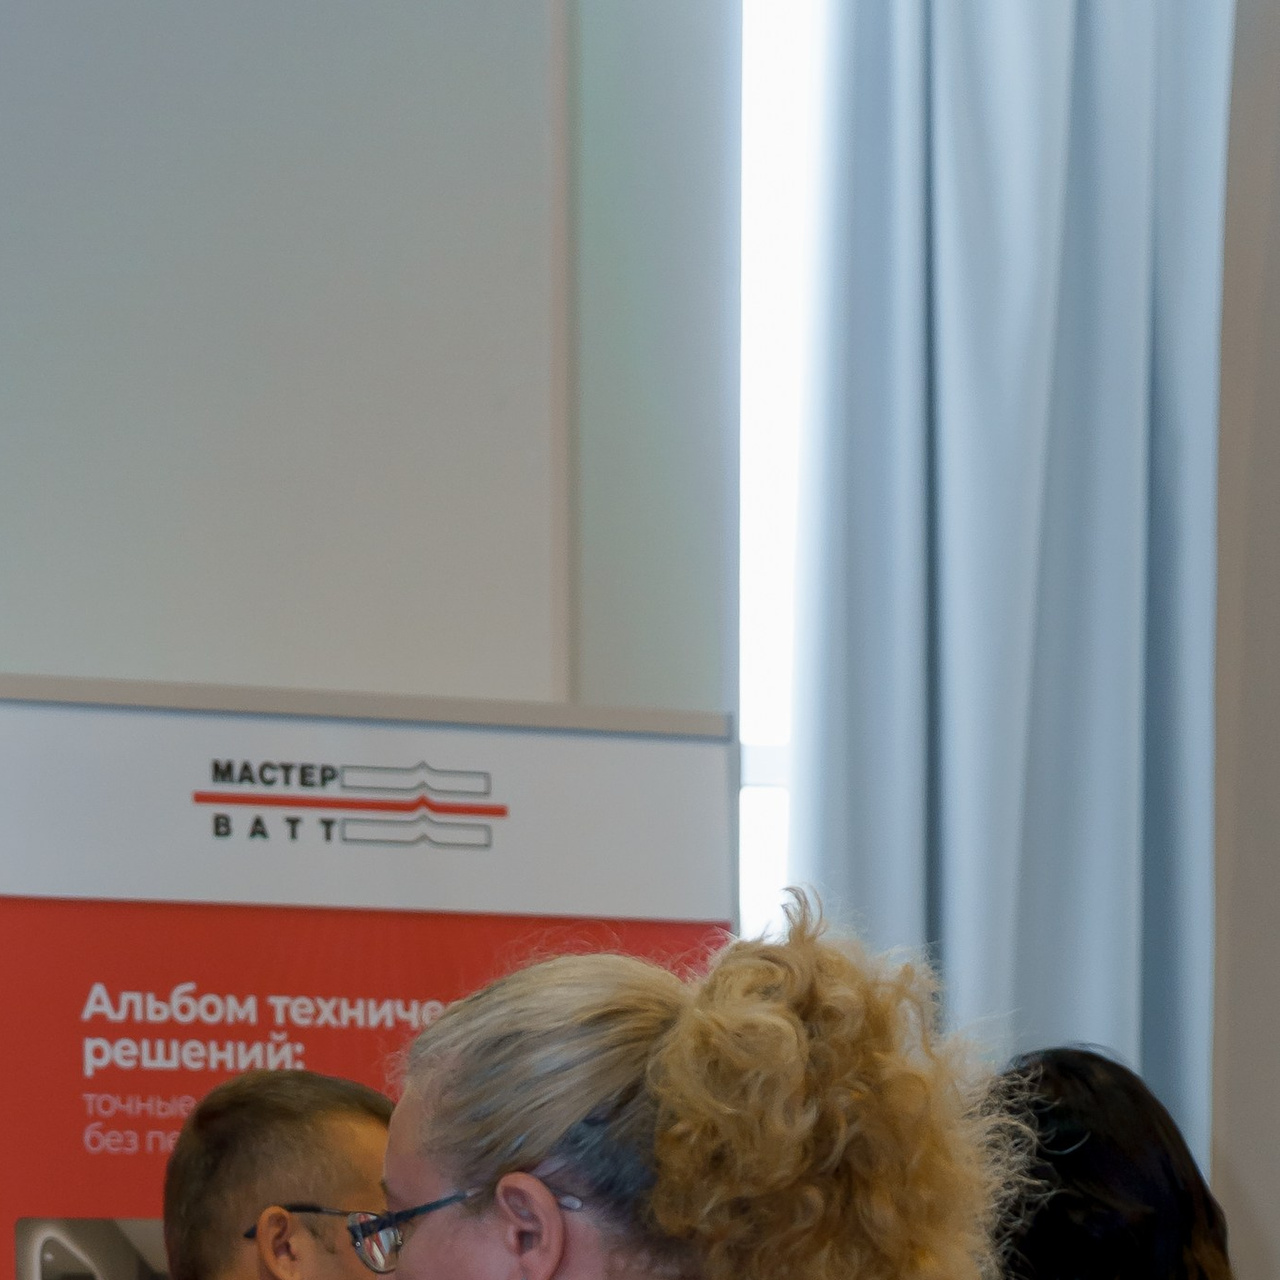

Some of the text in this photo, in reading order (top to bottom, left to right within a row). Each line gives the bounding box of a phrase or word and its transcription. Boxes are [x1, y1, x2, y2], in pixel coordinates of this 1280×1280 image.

[211, 759, 339, 788] МАСТЕР
[213, 813, 337, 842] ВАТТ
[82, 982, 258, 1025] Альбом
[82, 1032, 306, 1077] решений:
[83, 1121, 139, 1155] без
